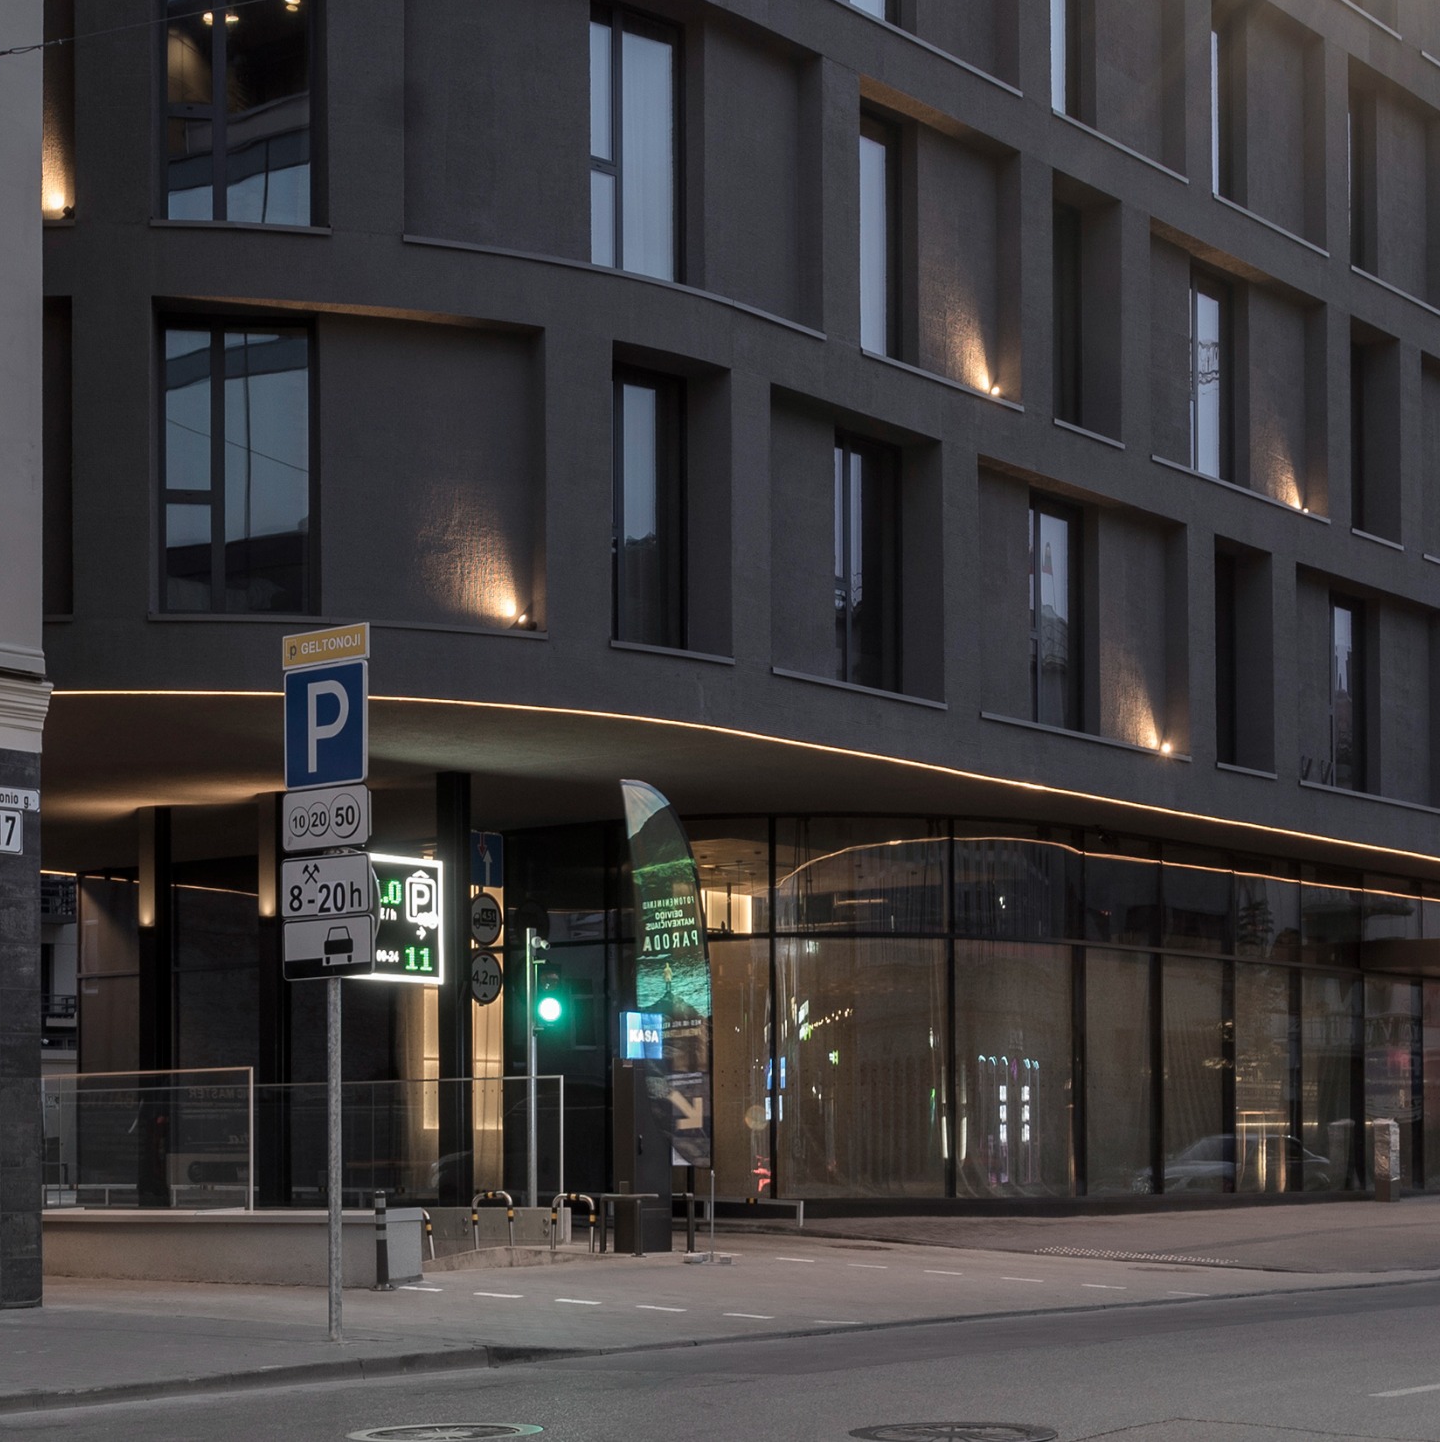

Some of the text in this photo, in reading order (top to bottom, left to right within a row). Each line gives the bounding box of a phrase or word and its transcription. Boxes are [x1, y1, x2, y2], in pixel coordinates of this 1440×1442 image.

[301, 633, 361, 655] GELTONOJI
[307, 679, 350, 774] P
[23, 796, 31, 809] g.
[292, 804, 355, 830] 10 20 50
[405, 946, 433, 971] 11
[629, 1028, 659, 1044] KASA
